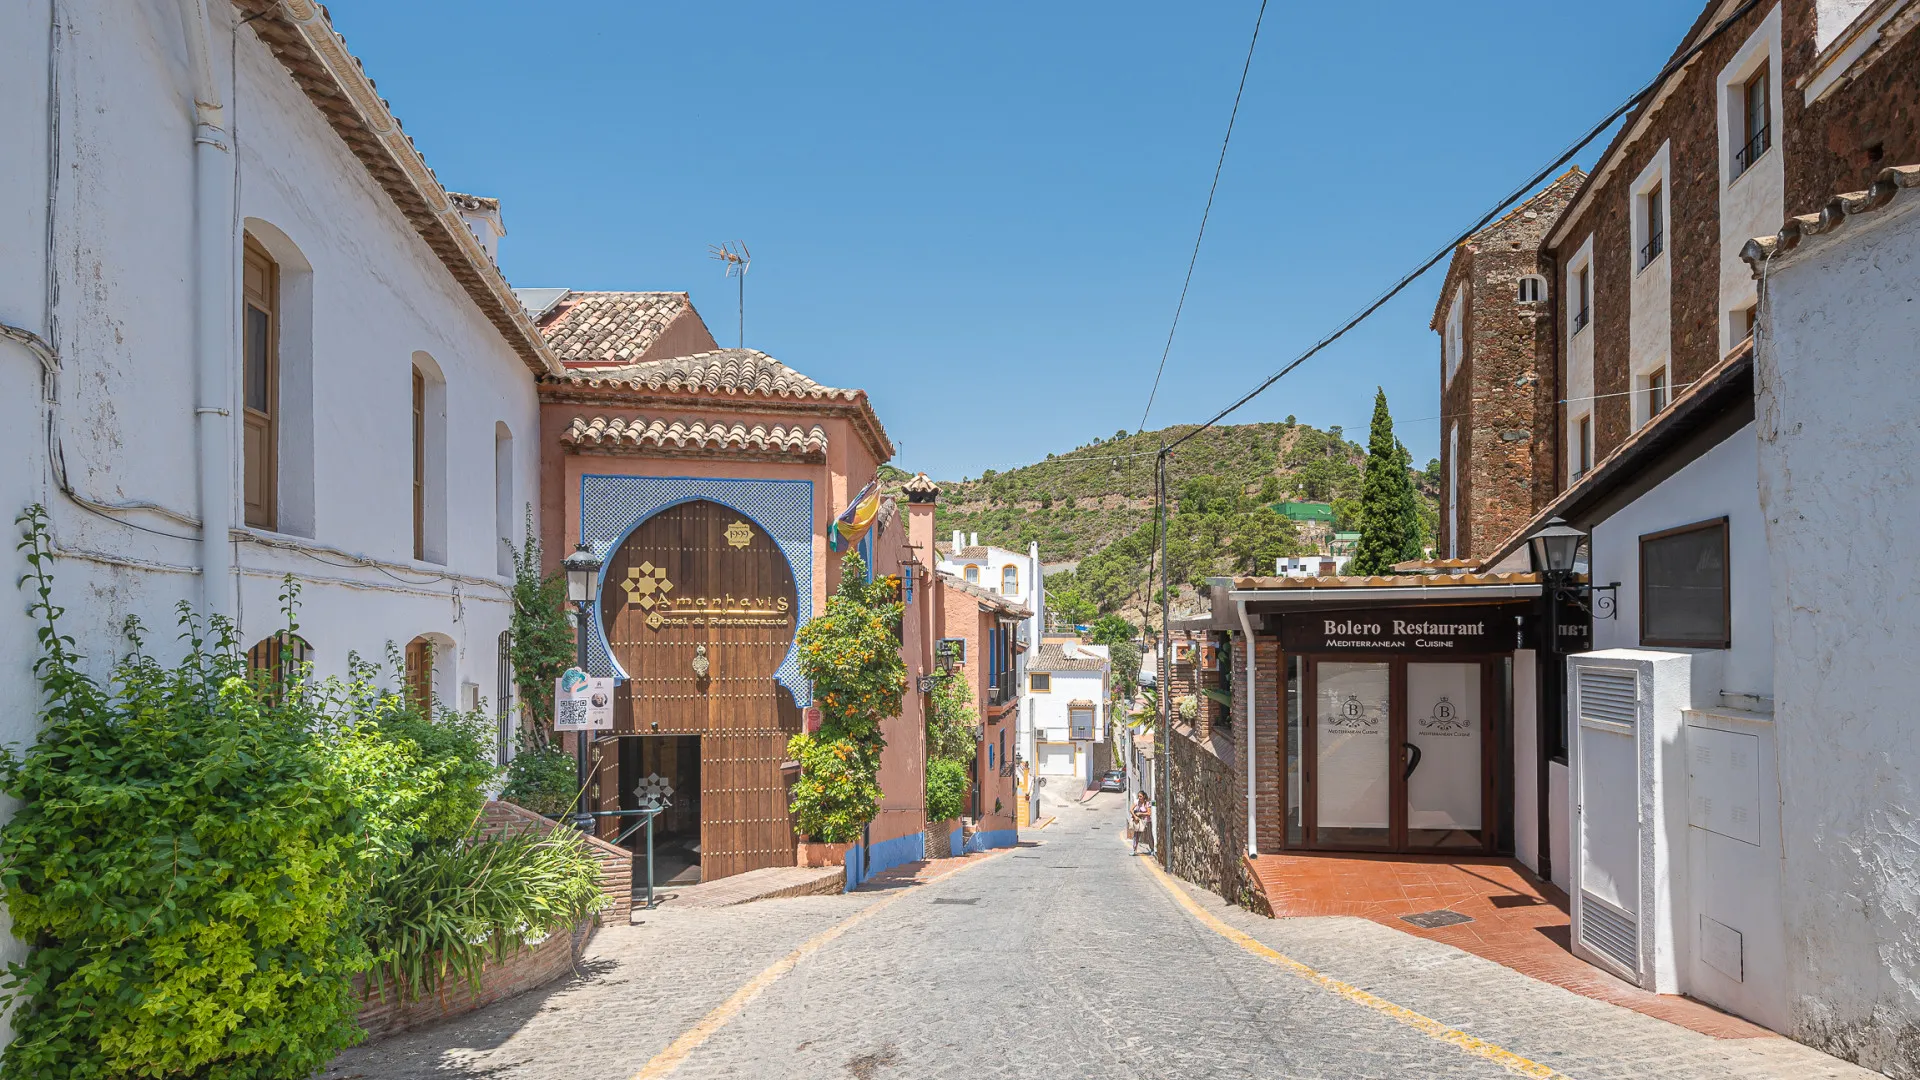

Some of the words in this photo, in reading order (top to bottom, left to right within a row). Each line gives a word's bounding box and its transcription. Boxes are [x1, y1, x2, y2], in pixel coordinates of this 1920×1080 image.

[730, 530, 749, 539] 1999
[649, 616, 689, 625] Hotel
[692, 617, 705, 625] &
[708, 617, 789, 625] Restaurante
[1324, 620, 1381, 635] Bolero
[1392, 620, 1485, 635] Restaurant
[1325, 639, 1406, 648] MEDITERRANEAN
[1415, 639, 1454, 648] CUISINE
[1348, 703, 1359, 716] B
[1440, 705, 1450, 718] B
